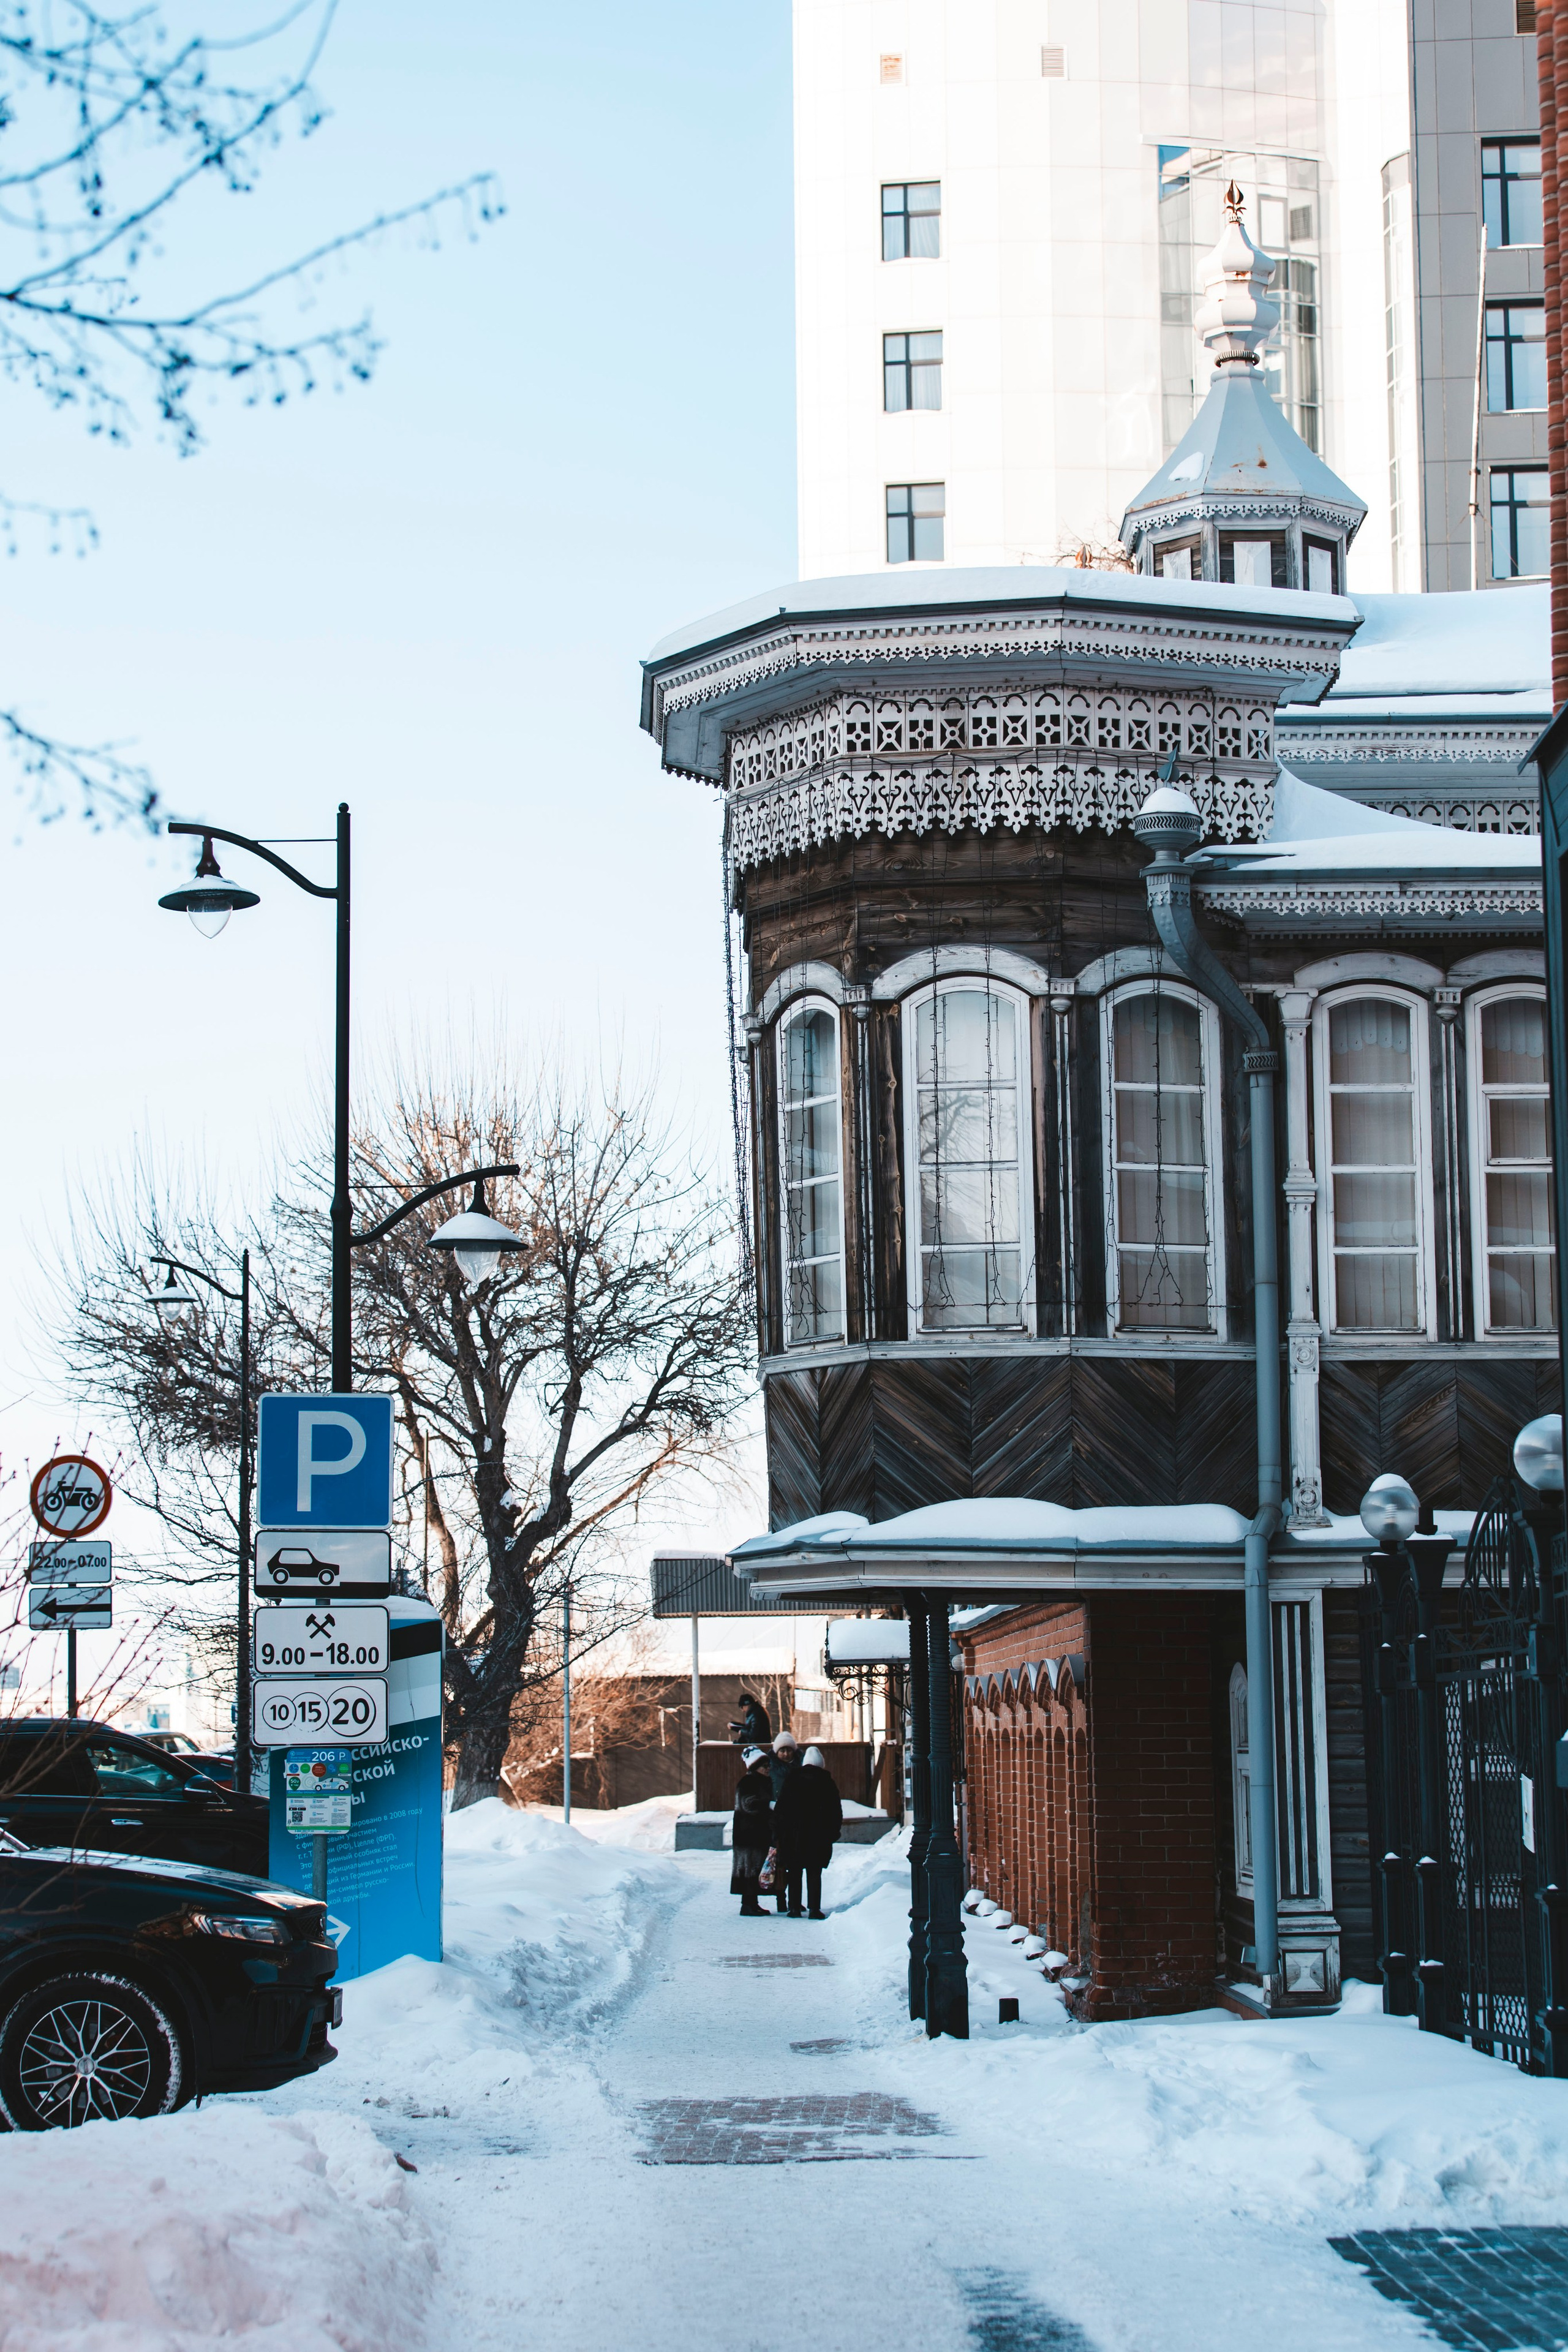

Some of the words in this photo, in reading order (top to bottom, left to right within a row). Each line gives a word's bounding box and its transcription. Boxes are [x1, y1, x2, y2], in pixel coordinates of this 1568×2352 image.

[297, 1411, 366, 1512] P
[270, 1704, 289, 1721] 10
[298, 1701, 322, 1722] 15
[332, 1698, 370, 1725] 20
[312, 1751, 335, 1762] 206
[389, 1810, 406, 1819] 2008
[346, 1828, 377, 1841] участием
[353, 1839, 375, 1848] Целле
[354, 1848, 382, 1858] особняк
[328, 1860, 374, 1874] официальных
[376, 1855, 398, 1864] встреч
[350, 1869, 382, 1880] Германии
